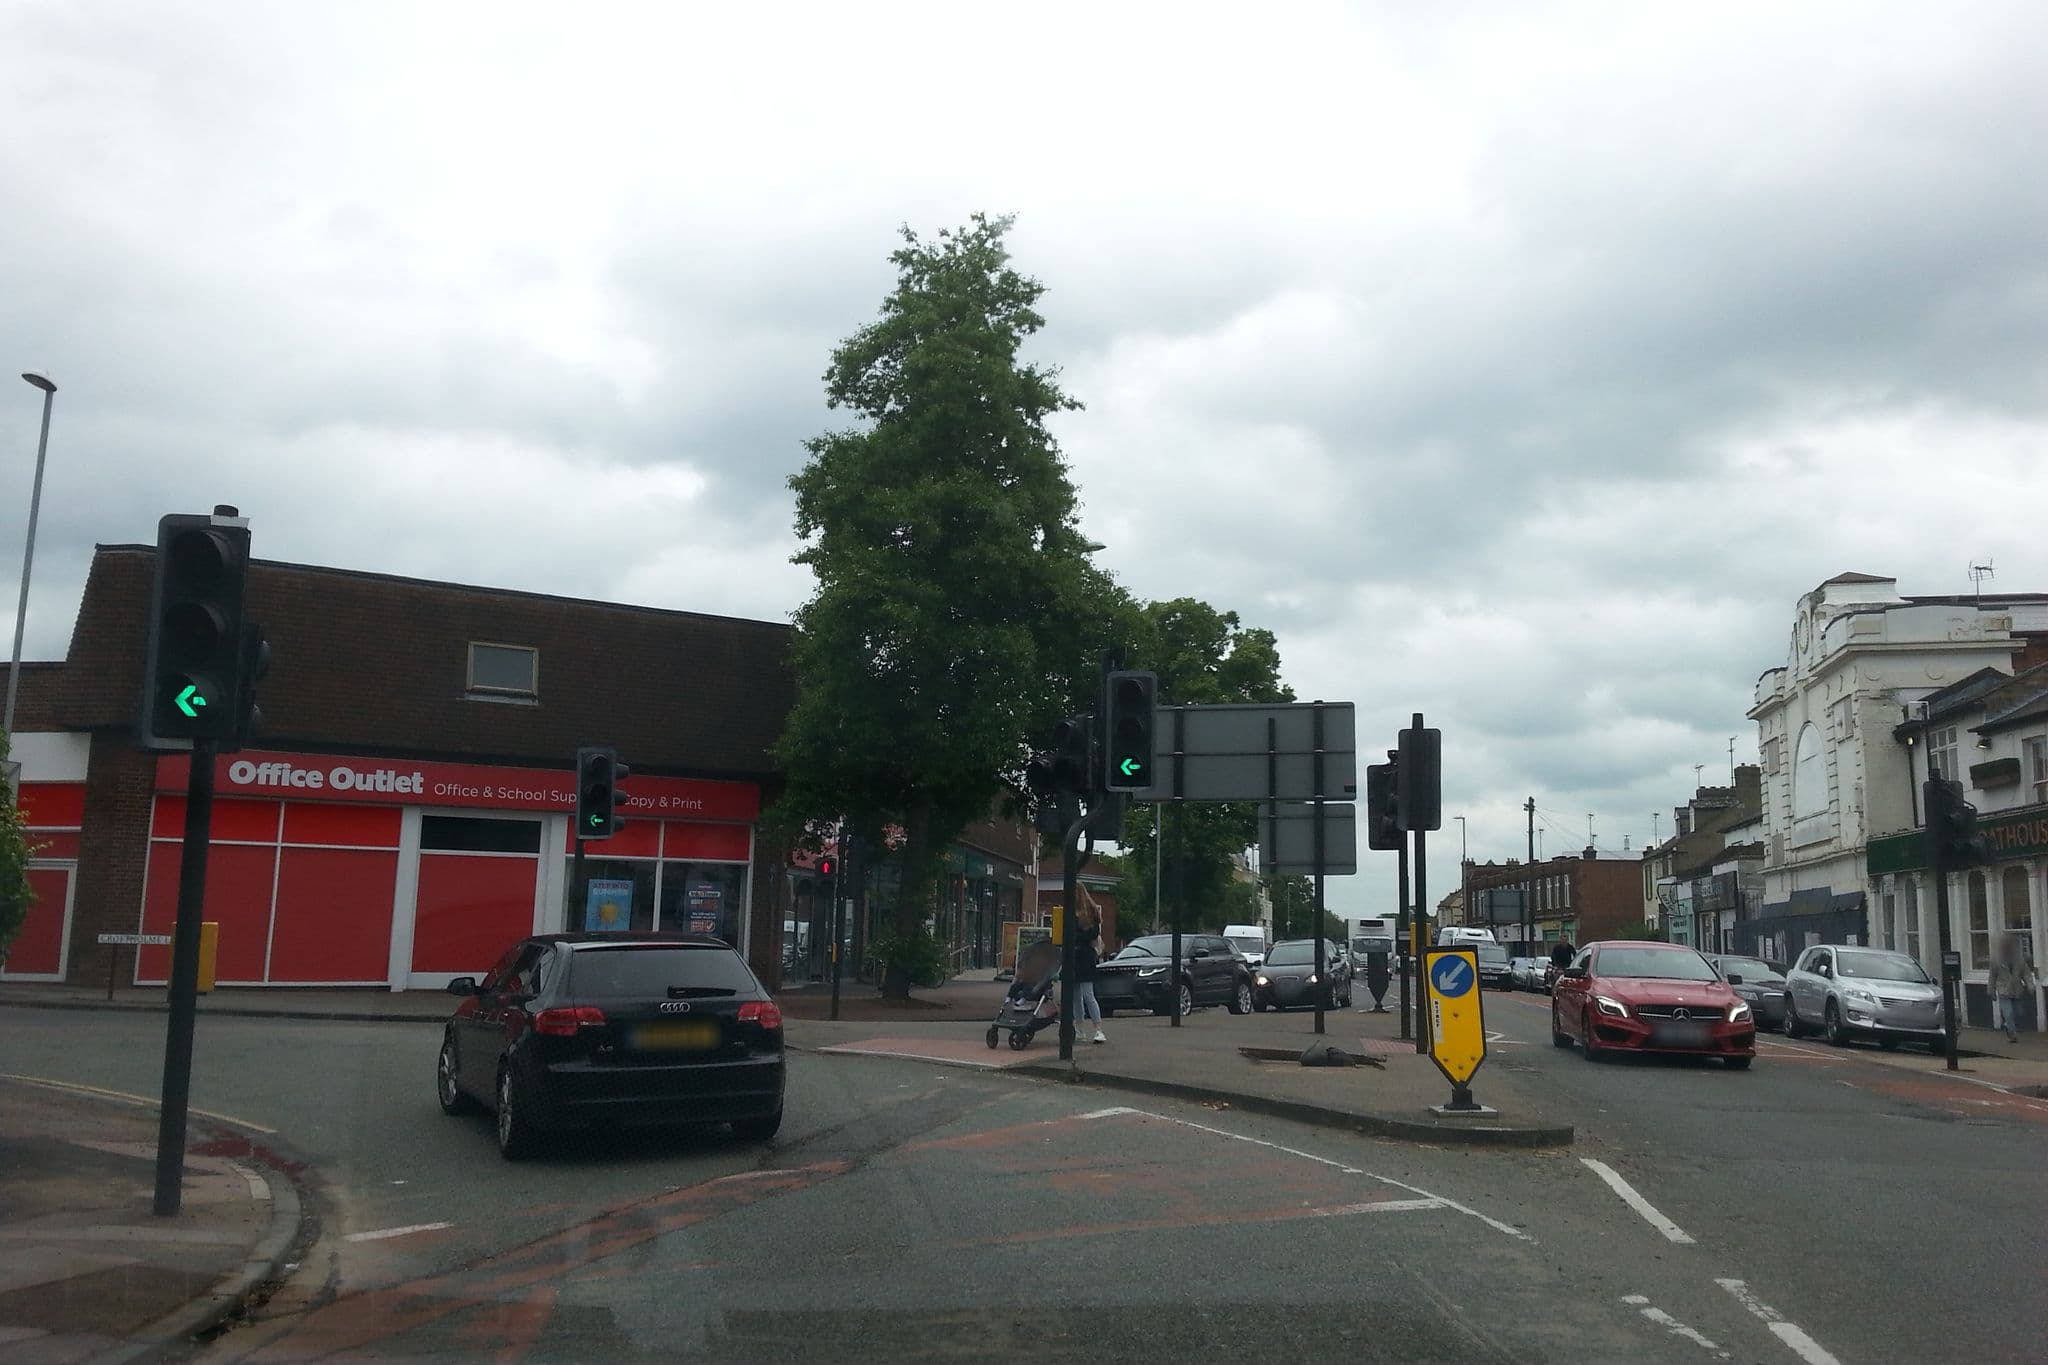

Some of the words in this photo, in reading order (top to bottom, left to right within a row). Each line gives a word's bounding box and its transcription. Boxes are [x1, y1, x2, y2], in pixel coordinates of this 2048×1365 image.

[229, 760, 324, 789] Office
[329, 766, 424, 794] Outlet
[434, 783, 479, 797] Office
[483, 786, 493, 798] &
[498, 787, 546, 801] School
[659, 796, 668, 808] &
[672, 797, 703, 810] Print
